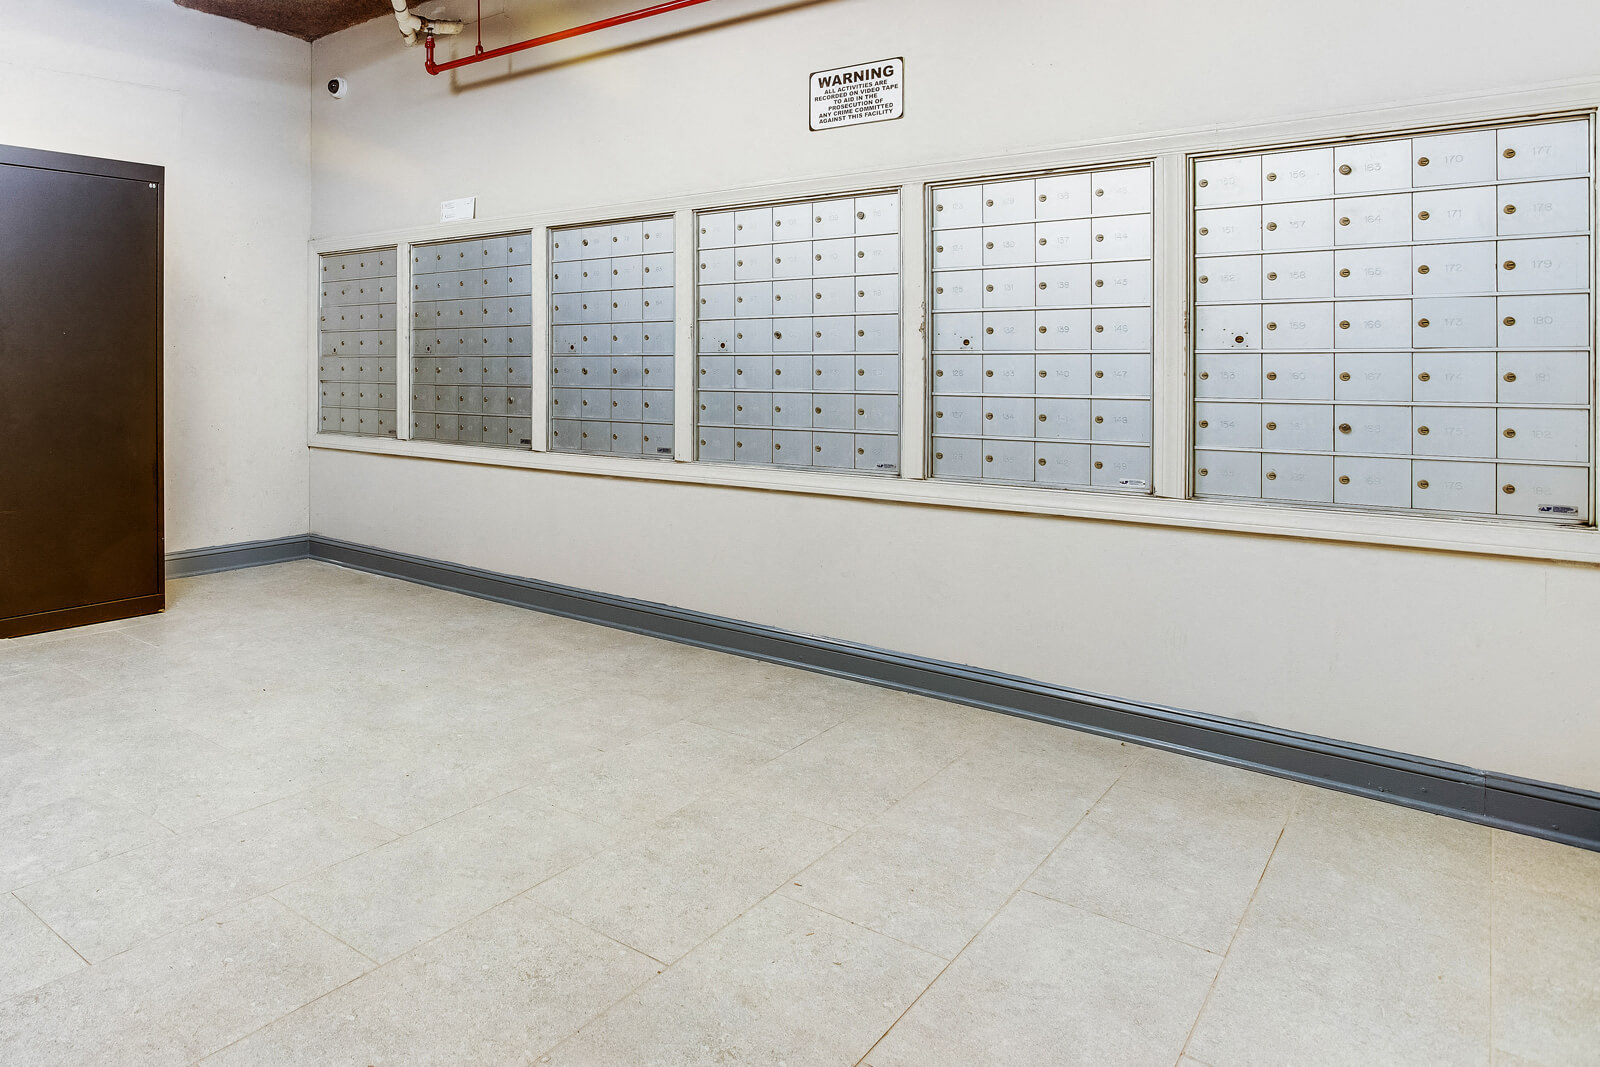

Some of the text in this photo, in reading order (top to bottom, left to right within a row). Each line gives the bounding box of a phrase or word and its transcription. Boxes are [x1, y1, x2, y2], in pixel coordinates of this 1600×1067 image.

[818, 65, 894, 88] WARNING
[838, 82, 872, 92] ACTIVITIES
[815, 92, 847, 102] RECORDED
[828, 100, 873, 111] PROSECUTION
[855, 103, 893, 113] COMMITTED
[819, 116, 845, 124] AGAINST
[865, 109, 893, 117] FACILITY
[1532, 145, 1552, 156] 177
[1444, 154, 1463, 164] 170
[1364, 162, 1381, 172] 163
[1532, 202, 1552, 212] 178
[1446, 209, 1462, 218] 171
[1365, 215, 1381, 224] 164
[1444, 264, 1463, 273] 172
[1532, 259, 1552, 269] 179
[1290, 271, 1306, 279] 158
[1289, 321, 1306, 330] 159
[1532, 316, 1553, 325] 180
